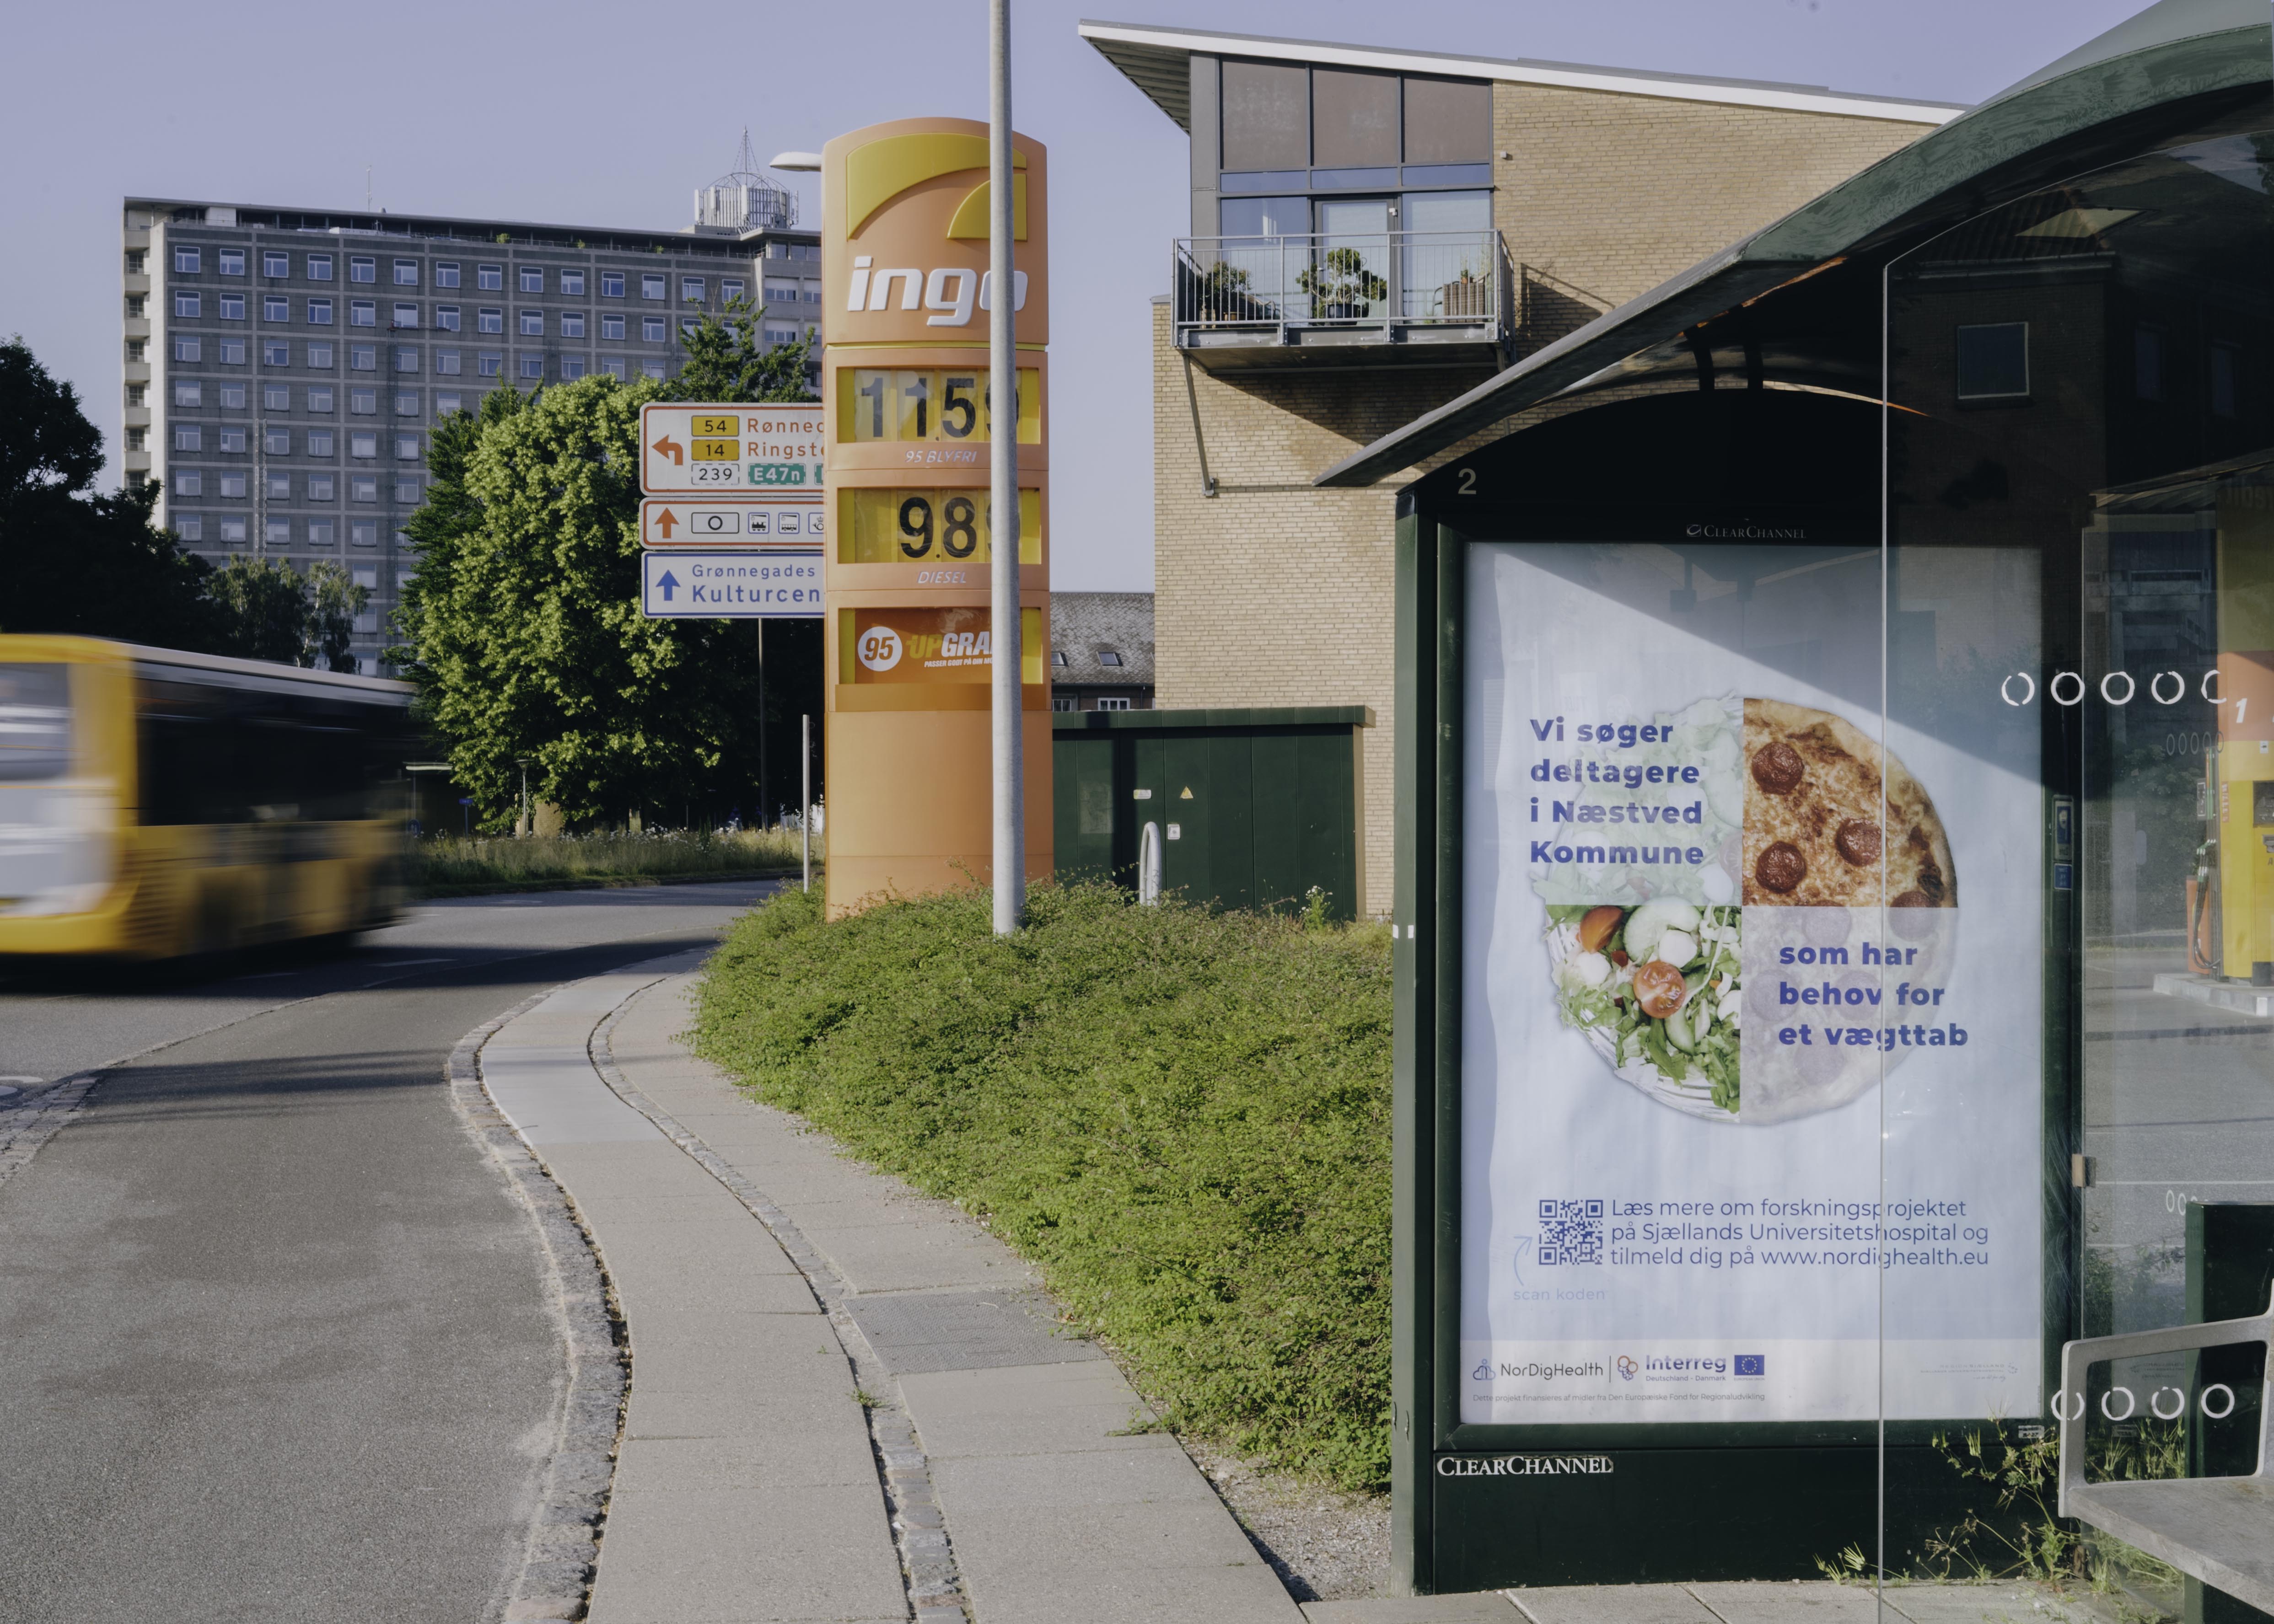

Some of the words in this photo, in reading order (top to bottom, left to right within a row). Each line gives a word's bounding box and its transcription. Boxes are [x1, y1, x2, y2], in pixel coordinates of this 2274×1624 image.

[705, 420, 726, 432] 54
[706, 444, 725, 456] 14
[747, 442, 823, 459] Ringst
[905, 450, 922, 463] 95
[925, 450, 977, 463] BLYFRI
[699, 468, 732, 481] 239
[754, 468, 800, 481] E47n
[1458, 468, 1476, 494] 2
[918, 571, 967, 584] DIESEL
[864, 636, 894, 661] 95
[906, 631, 992, 659] UPGRA
[924, 659, 946, 668] PASSER
[2235, 698, 2247, 724] 1
[1530, 716, 1564, 741] Vi
[1577, 723, 1673, 748] søger
[1531, 759, 1699, 788] deltagere
[1531, 797, 1538, 822] i
[1552, 801, 1702, 824] Næstved
[1531, 841, 1704, 864] Kommune
[1779, 946, 1849, 965] som
[1862, 942, 1918, 965] har
[1779, 981, 1882, 1005] behov
[1896, 982, 1945, 1006] for
[1779, 1024, 1812, 1045] et
[1824, 1023, 1968, 1051] vægttab
[1613, 1200, 1653, 1216] Læs
[1660, 1202, 1714, 1216] mere
[1721, 1202, 1754, 1216] om
[1761, 1198, 1967, 1221] forskningsprojektet
[1612, 1222, 1636, 1244] på
[1643, 1222, 1743, 1244] Sjællands
[1750, 1223, 1956, 1245] Universitetshospital
[1963, 1227, 1989, 1245] og
[1611, 1247, 1683, 1265] tilmeld
[1690, 1247, 1722, 1269] dig
[1730, 1245, 1754, 1269] på
[1761, 1247, 1989, 1270] www.nordighealth.eu
[1513, 1291, 1550, 1300] scan
[1556, 1287, 1605, 1300] koden
[1501, 1362, 1603, 1380] NorDigHealth
[1646, 1355, 1726, 1372] Interreg
[1495, 1394, 1521, 1403] projekt
[1625, 1394, 1667, 1402] Europæiske
[1701, 1393, 1765, 1402] Regionaludvikling
